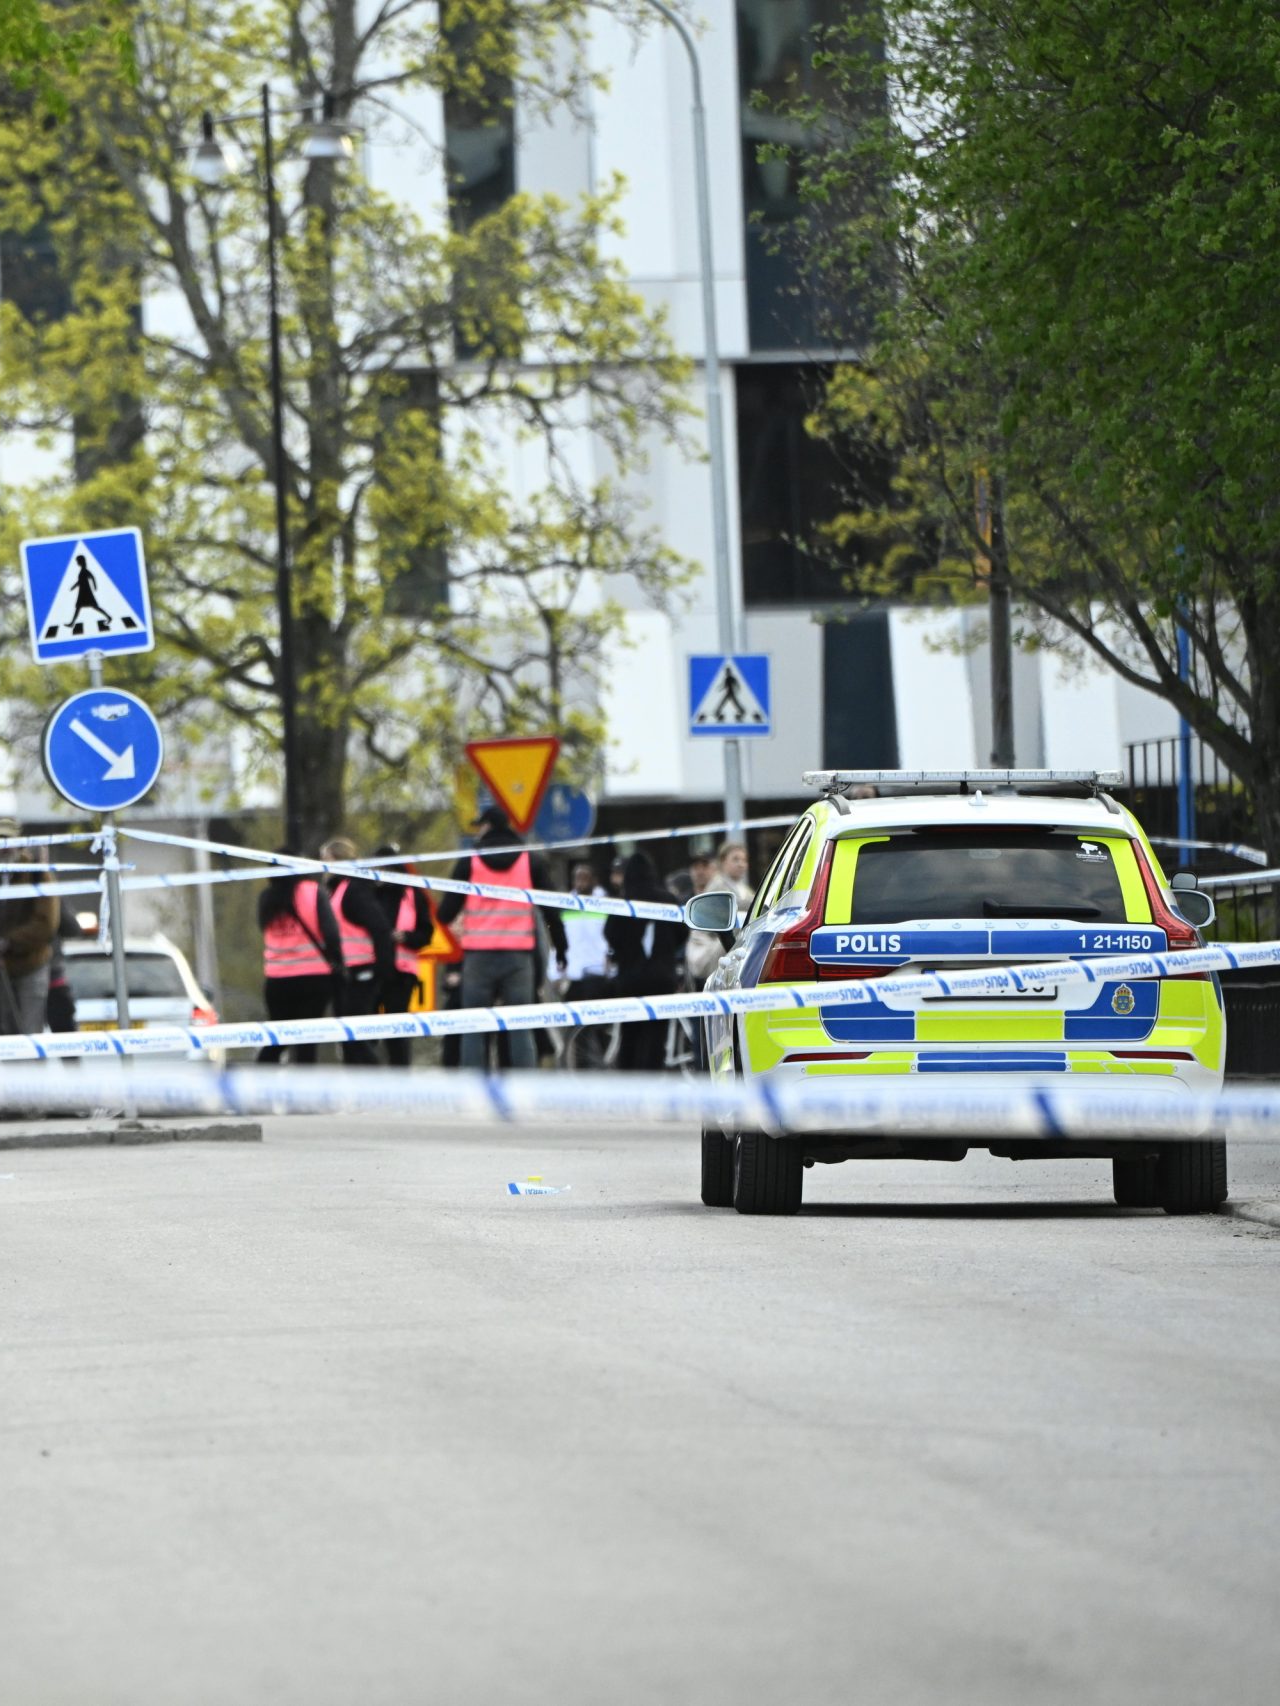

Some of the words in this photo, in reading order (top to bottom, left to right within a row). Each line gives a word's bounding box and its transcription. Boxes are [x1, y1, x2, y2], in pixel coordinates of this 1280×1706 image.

[836, 934, 901, 953] POLIS
[1078, 934, 1086, 949] 1
[1093, 935, 1152, 950] 21-1150
